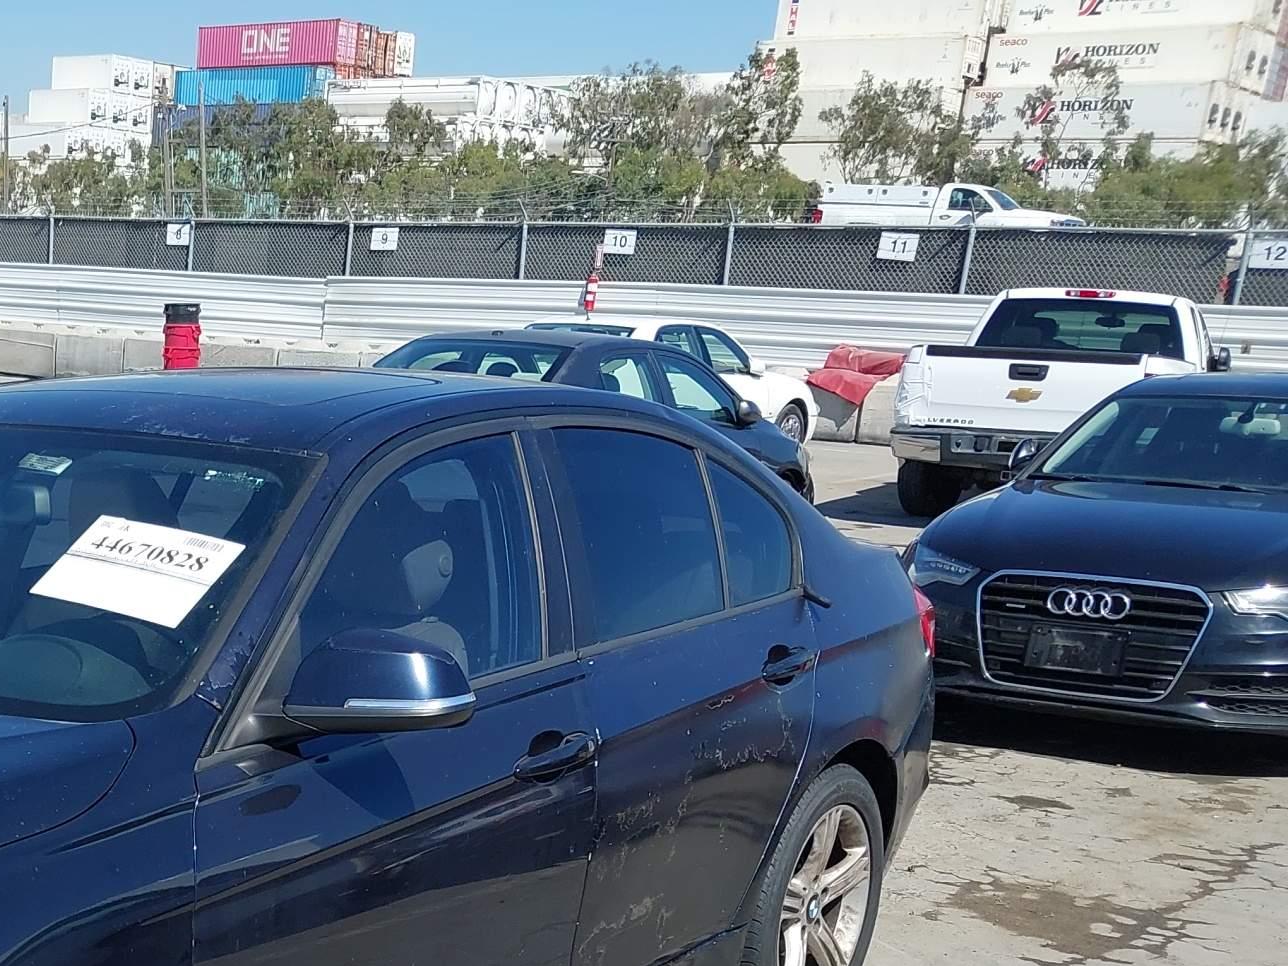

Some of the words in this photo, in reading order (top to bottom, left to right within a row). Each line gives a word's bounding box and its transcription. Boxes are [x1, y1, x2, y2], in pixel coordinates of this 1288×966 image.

[241, 28, 290, 54] ONE
[999, 38, 1028, 47] seaco
[1084, 42, 1160, 57] HORIZON
[1060, 99, 1134, 111] HORIZON
[176, 230, 182, 240] 8
[382, 232, 388, 245] 9
[612, 235, 627, 248] 10
[891, 239, 907, 253] 11
[1264, 246, 1287, 260] 12
[91, 535, 209, 571] 44670828
